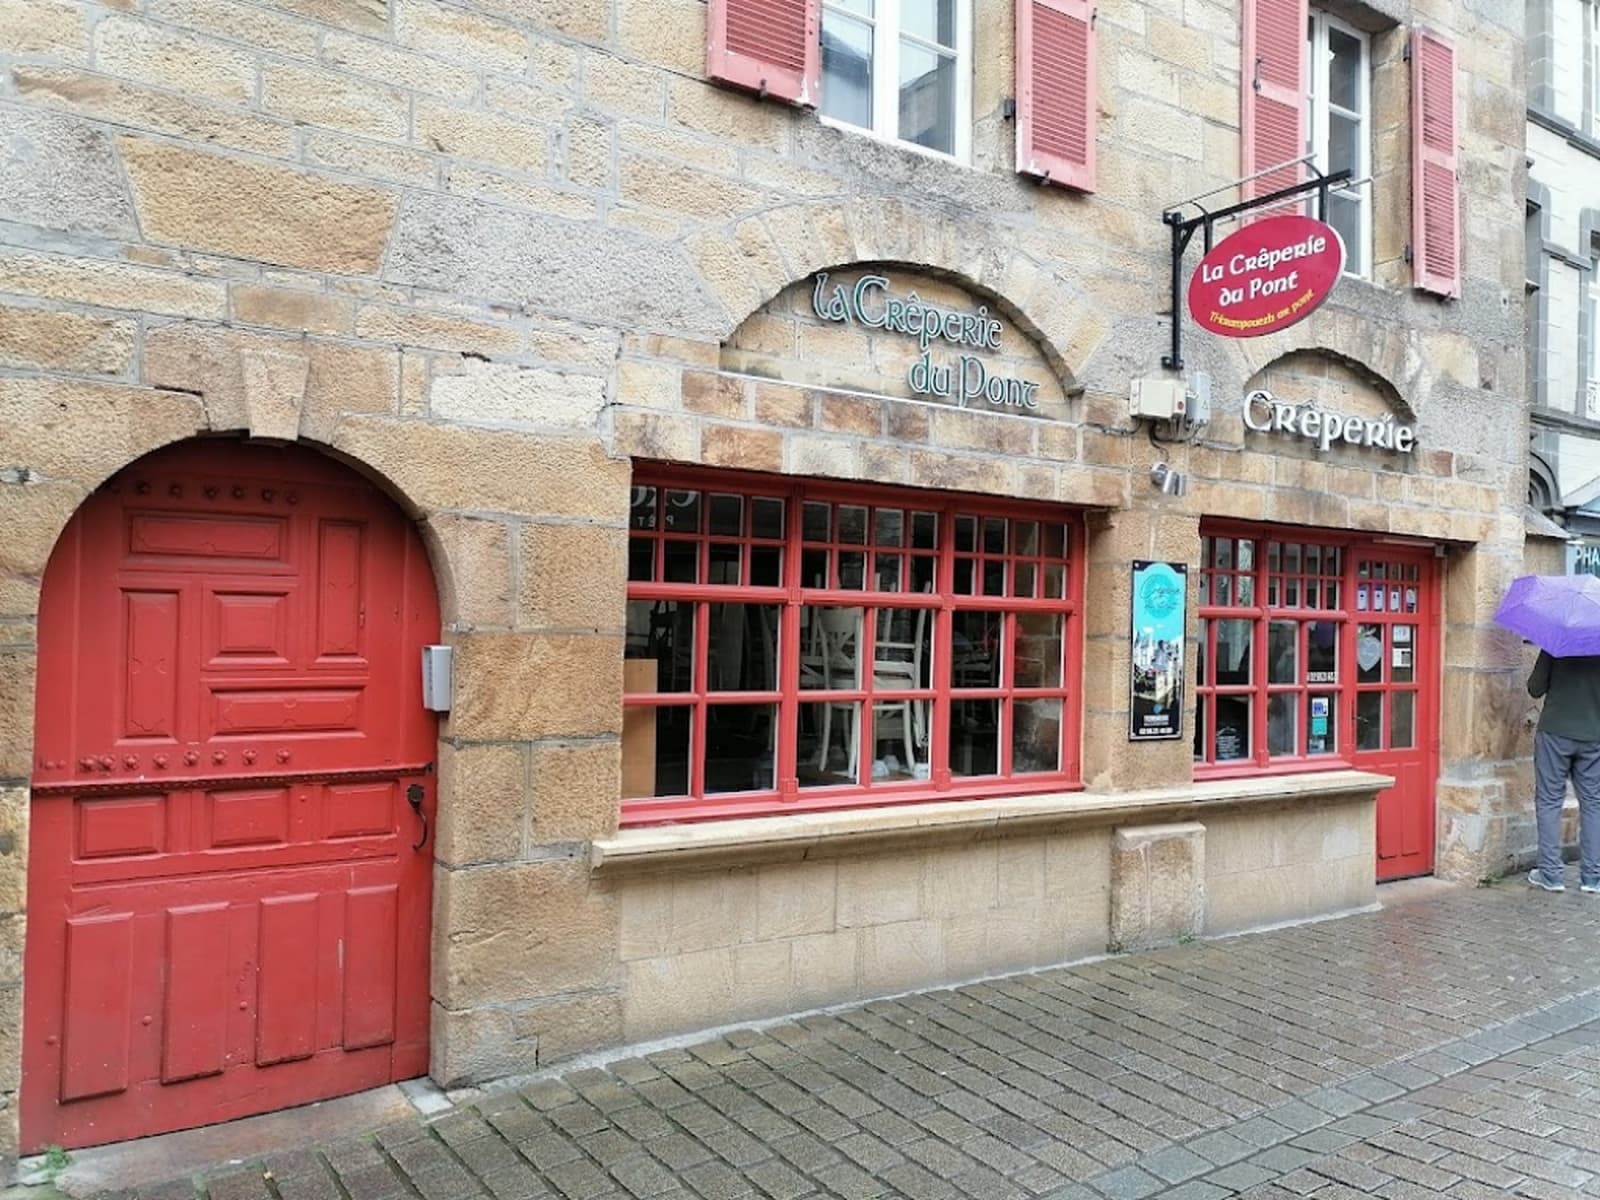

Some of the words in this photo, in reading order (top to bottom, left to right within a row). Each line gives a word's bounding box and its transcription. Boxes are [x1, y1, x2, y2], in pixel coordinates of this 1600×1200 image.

[1202, 264, 1224, 283] La
[1229, 235, 1327, 275] Crêperie
[853, 275, 1003, 350] Crêperie
[1218, 287, 1245, 307] du
[1249, 270, 1299, 299] Pont
[909, 351, 950, 396] du
[959, 355, 1041, 408] Pont
[1242, 390, 1414, 452] Crêperie
